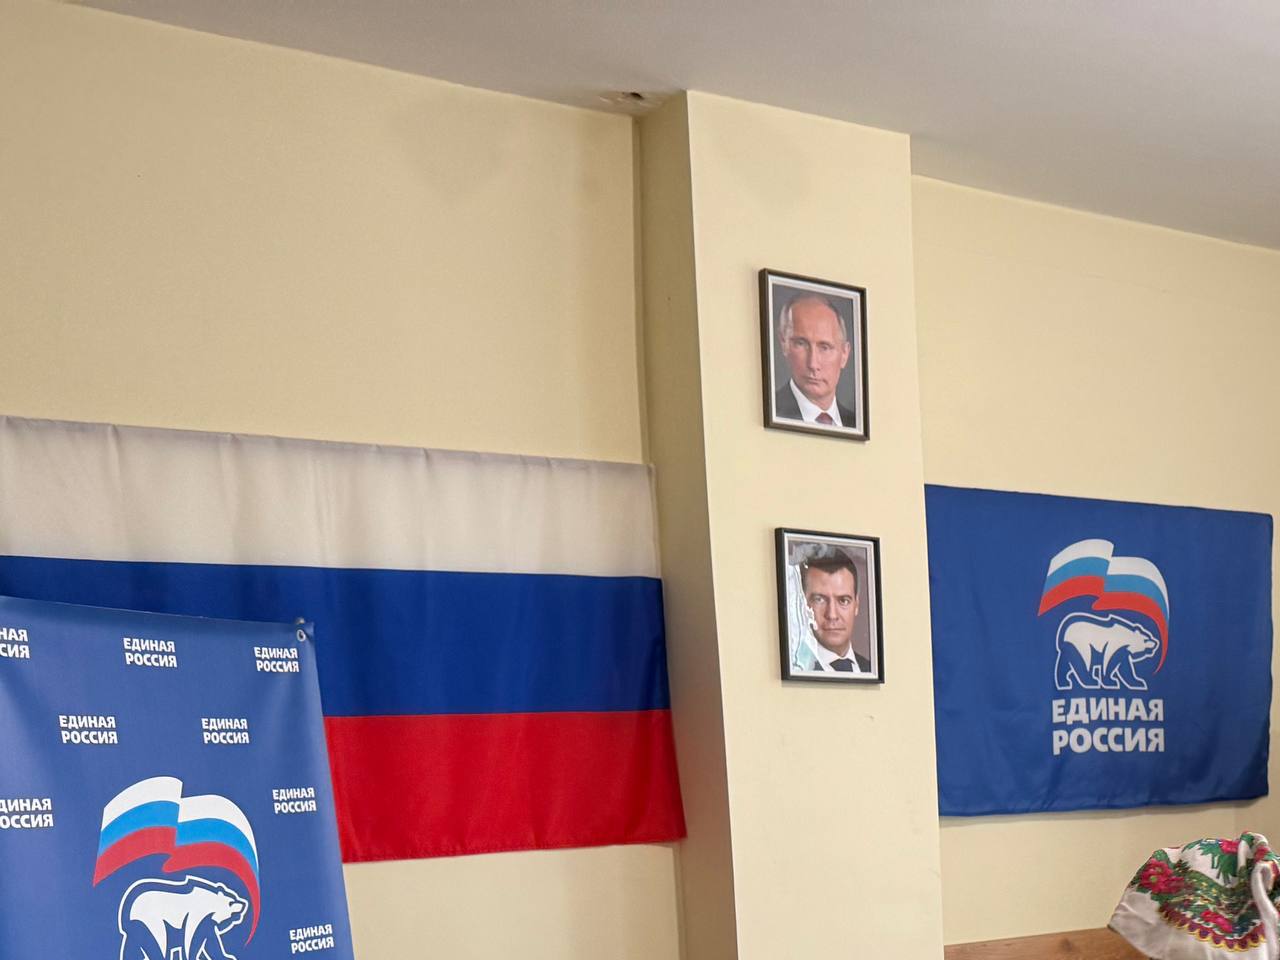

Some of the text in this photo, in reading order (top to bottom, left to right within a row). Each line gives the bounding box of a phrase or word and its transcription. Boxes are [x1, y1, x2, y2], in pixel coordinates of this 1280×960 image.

[123, 638, 175, 652] ЕДИНАЯ
[125, 652, 177, 667] РОССИЯ
[254, 647, 298, 659] ЕДИНАЯ
[256, 660, 299, 672] РОССИЯ
[1052, 697, 1163, 725] ЕДИНАЯ
[59, 715, 116, 729] ЕДИНАЯ
[201, 718, 247, 730] ЕДИНАЯ
[61, 731, 118, 744] РОССИЯ
[203, 732, 249, 744] РОССИЯ
[1053, 727, 1164, 755] РОССИЯ
[273, 787, 315, 801] ЕДИНАЯ
[0, 799, 51, 813] ДИНАЯ
[274, 800, 316, 814] РОССИЯ
[0, 814, 53, 828] ОССИЯ
[290, 924, 332, 941] ЕДИНАЯ
[291, 936, 334, 954] РОССИЯ
